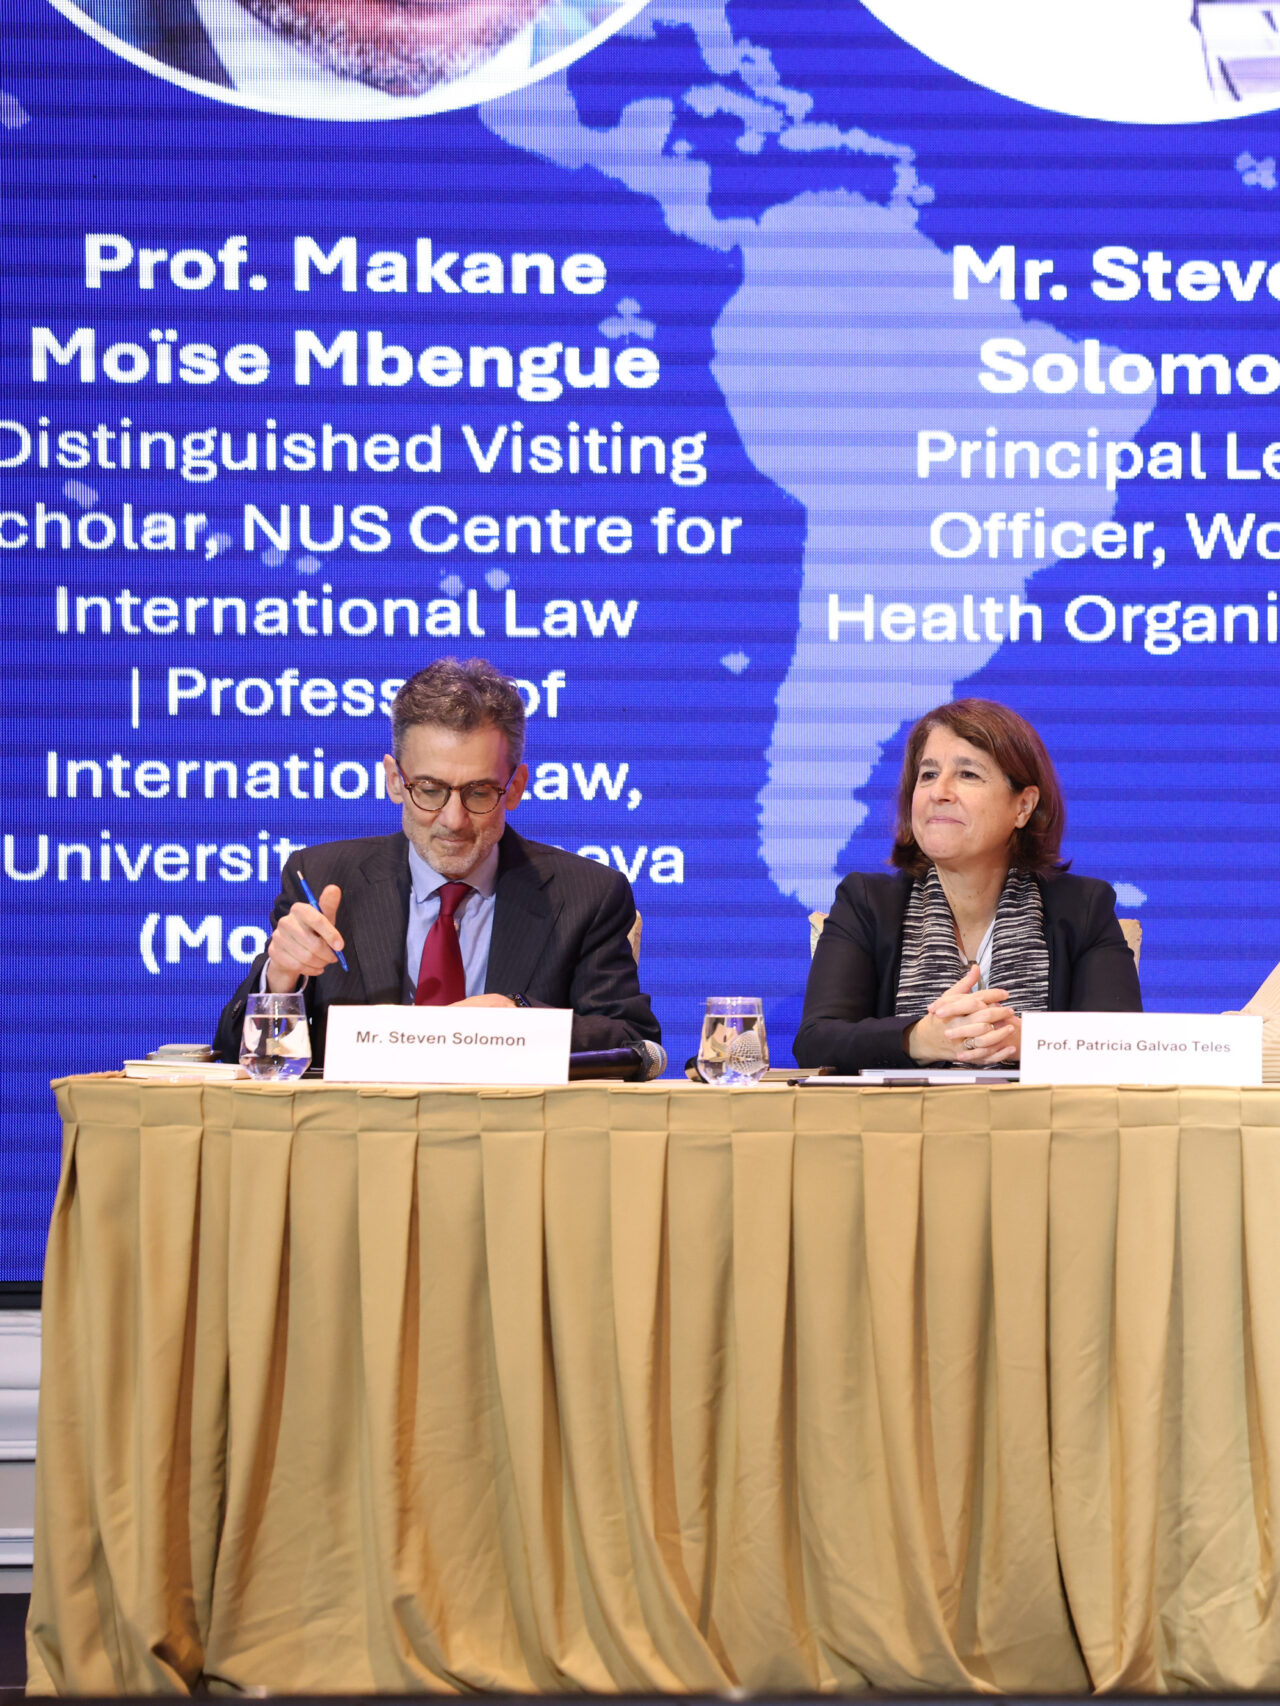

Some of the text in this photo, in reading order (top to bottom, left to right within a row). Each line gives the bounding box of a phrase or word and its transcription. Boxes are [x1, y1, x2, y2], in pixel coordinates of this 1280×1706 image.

[85, 233, 607, 295] Prof. Makane
[952, 245, 1068, 301] Mr.
[32, 327, 660, 402] Moïse Mbengue
[0, 416, 707, 486] Distinguished Visiting
[916, 426, 1207, 492] Principal
[0, 502, 743, 559] cholar, NUS Centre for
[929, 506, 1165, 568] Officer,
[56, 584, 638, 637] International Law
[828, 593, 1042, 643] Health
[46, 748, 644, 810] Internatio aw,
[551, 843, 686, 884] eva
[139, 911, 269, 976] (Mo
[355, 1030, 526, 1047] Mr. Steven Solomon
[1037, 1039, 1232, 1053] Prof. Patricia Galvao Teles
